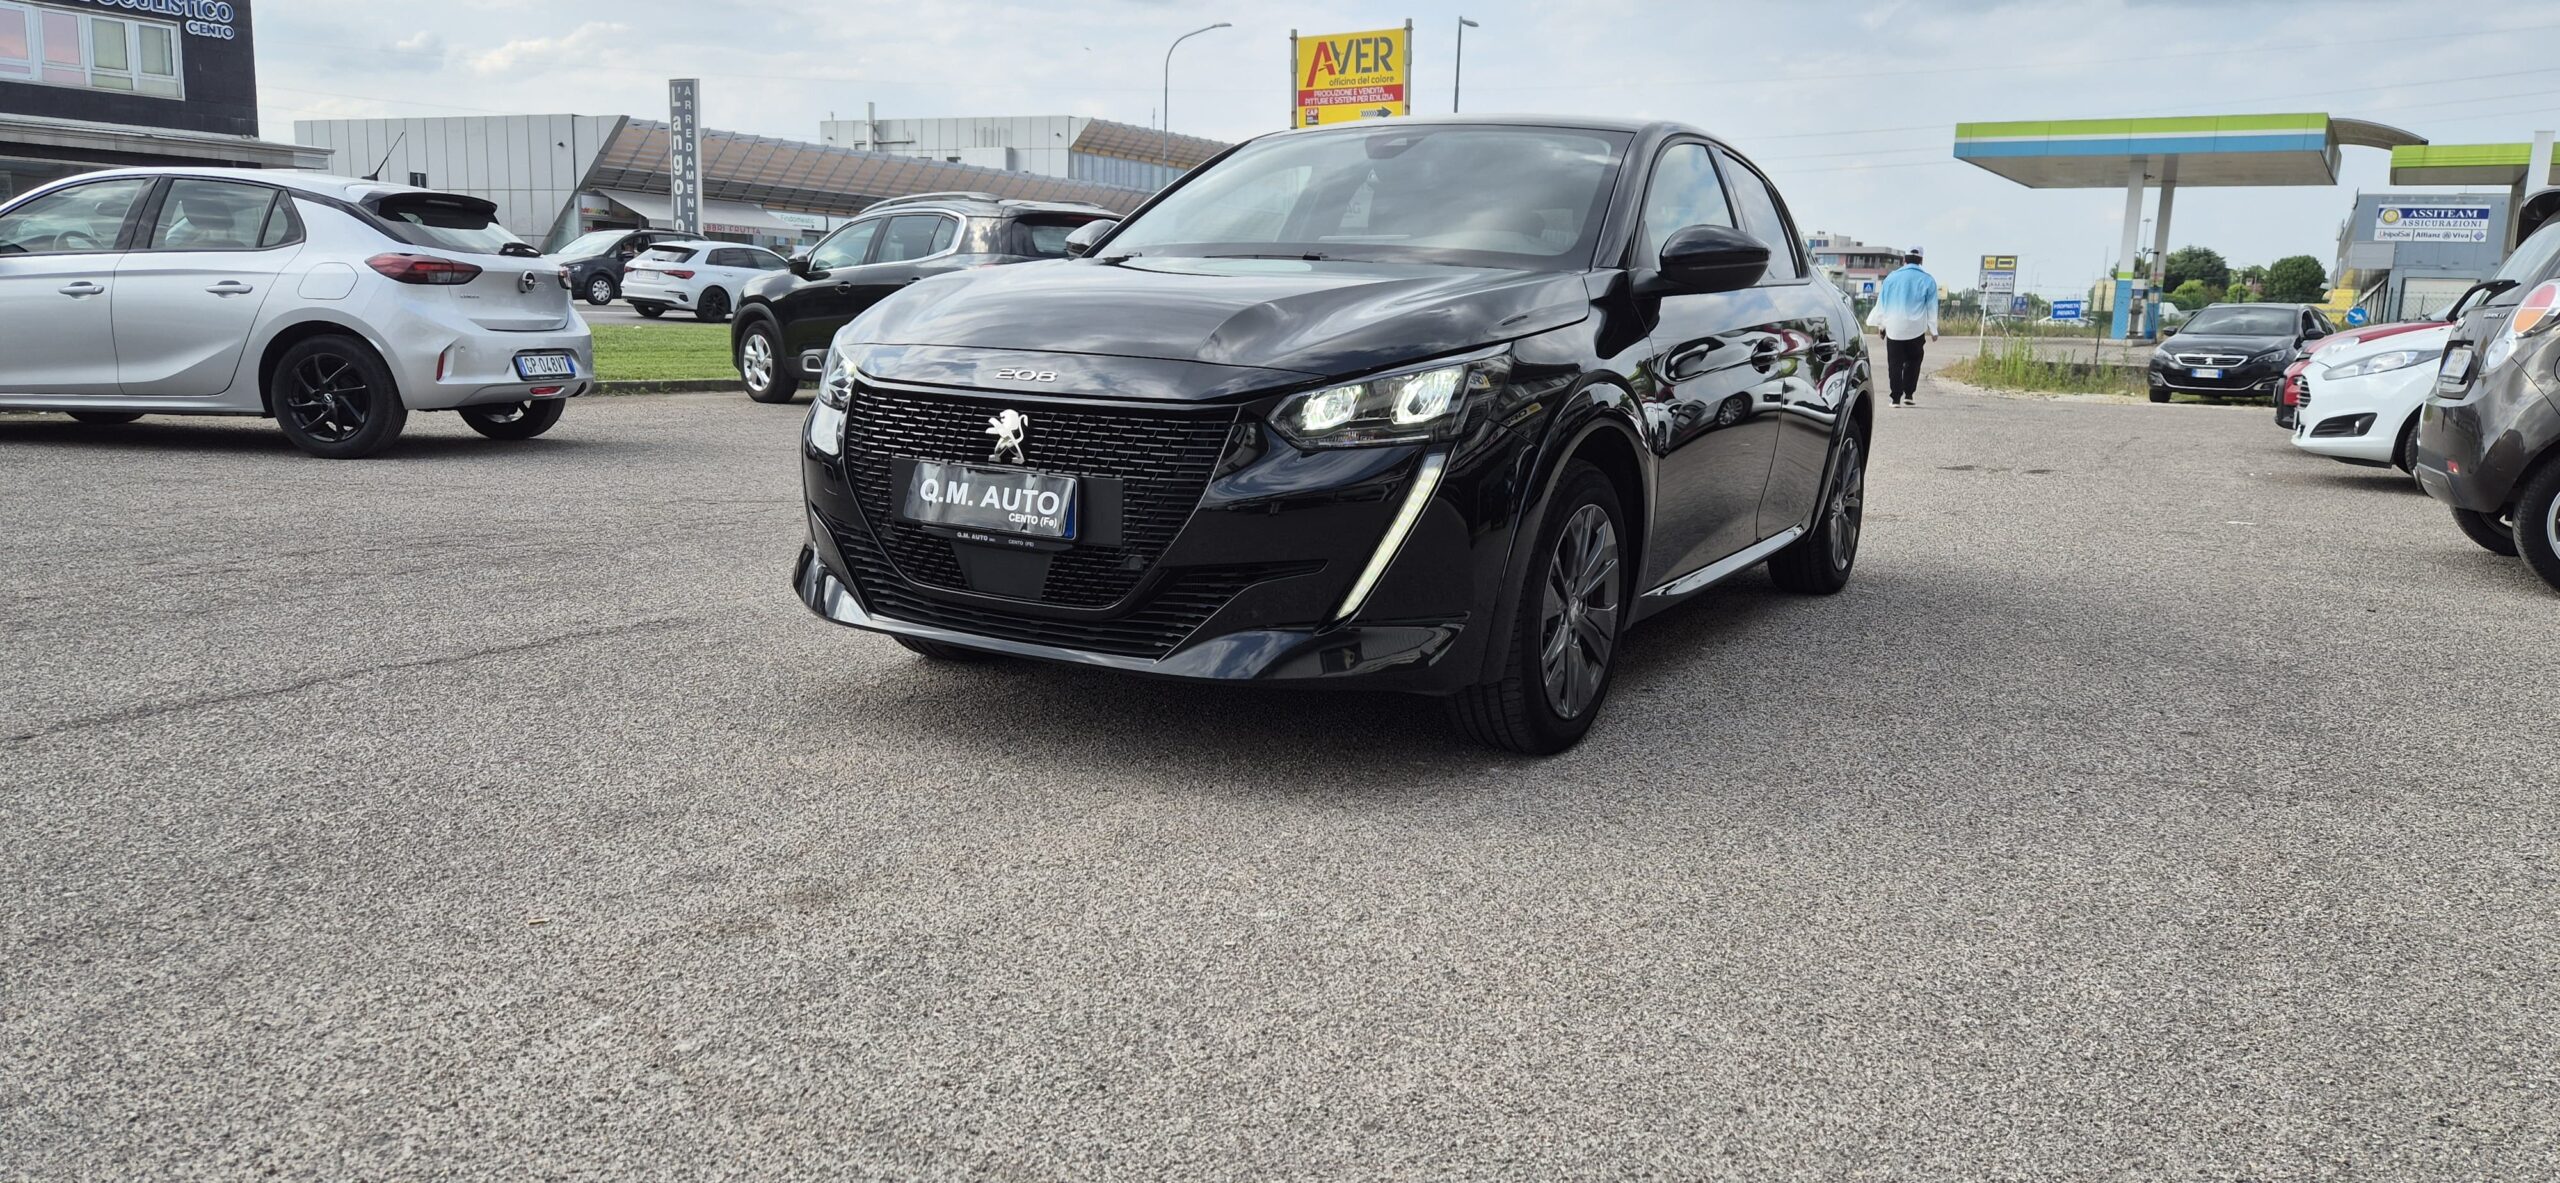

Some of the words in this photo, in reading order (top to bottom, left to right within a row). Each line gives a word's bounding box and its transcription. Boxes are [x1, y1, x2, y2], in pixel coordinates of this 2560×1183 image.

[98, 0, 234, 22] ULISTICO
[186, 20, 235, 39] CENTO
[1306, 37, 1393, 87] AVER
[1329, 77, 1356, 87] officina
[1357, 75, 1370, 85] del
[1371, 74, 1395, 84] colore
[1314, 88, 1353, 97] PRODUZIONE
[1359, 87, 1384, 95] VENDITA
[1305, 97, 1329, 105] PITTURE
[1334, 96, 1356, 104] SISTEMI
[671, 86, 685, 232] L'angolo
[684, 86, 695, 232] ARREDAMENTI
[2408, 209, 2478, 218] ASSITEAM
[2401, 220, 2482, 228] ASSICURAZIONI
[2415, 231, 2441, 239] Allianz
[524, 357, 537, 373] GP
[539, 356, 568, 373] 048VT
[995, 368, 1058, 382] 208
[920, 478, 974, 507] Q.M.
[980, 486, 1060, 515] AUTO
[1008, 512, 1039, 525] CENTO
[1040, 514, 1058, 528] (Fe)
[971, 533, 988, 541] AUTO
